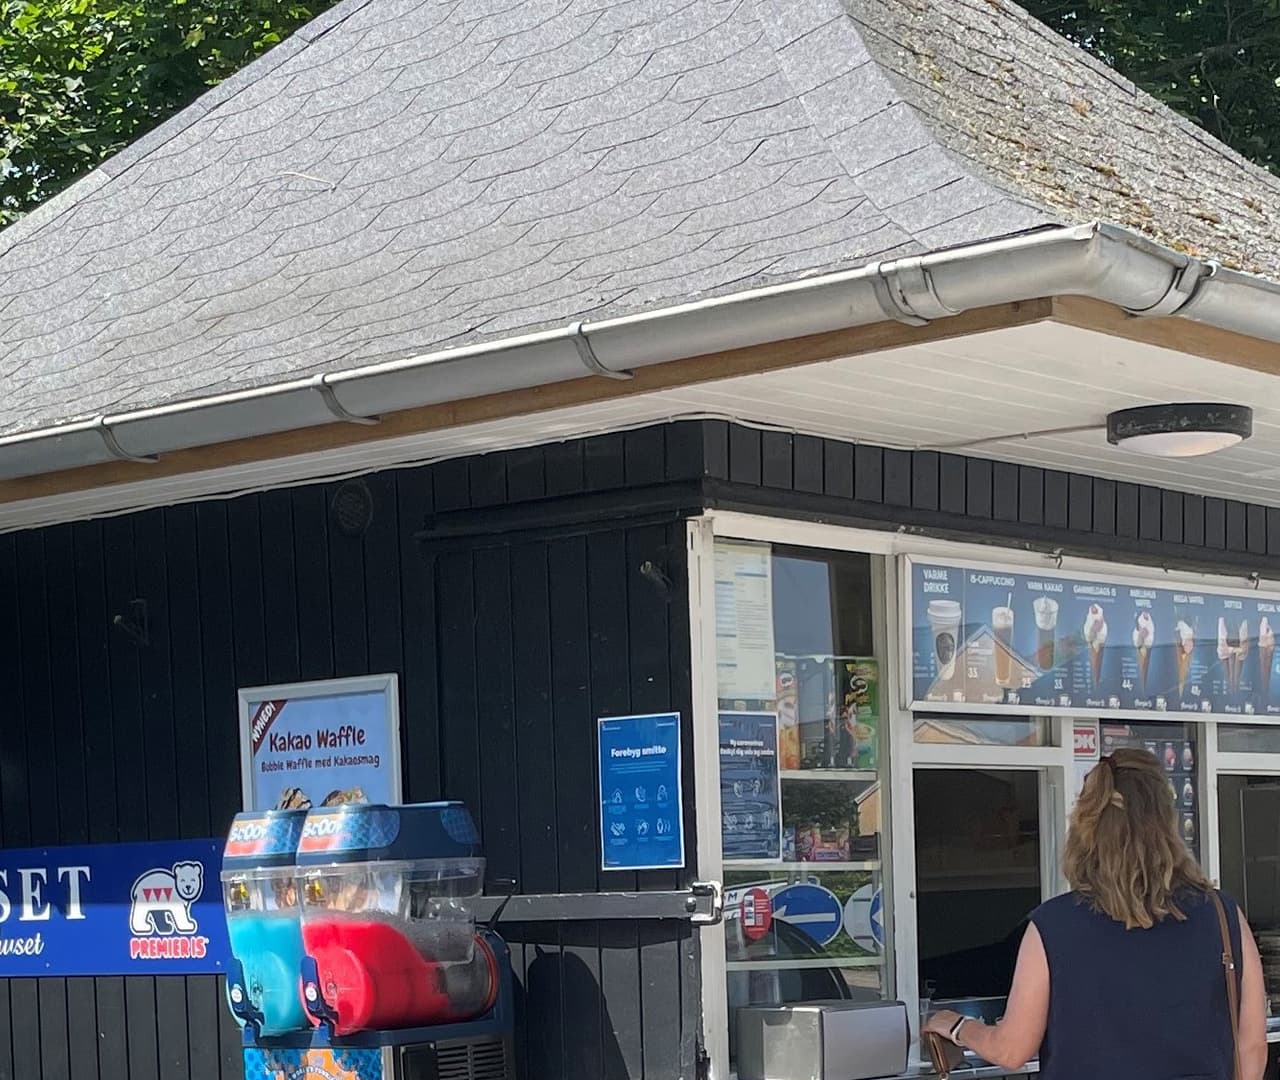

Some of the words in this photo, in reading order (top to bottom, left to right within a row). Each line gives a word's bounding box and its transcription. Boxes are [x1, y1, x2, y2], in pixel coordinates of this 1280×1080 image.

[270, 731, 312, 752] Kakao
[317, 725, 366, 748] Waffle
[611, 748, 641, 758] Forebyg
[642, 745, 667, 756] smitte
[261, 760, 284, 773] Bubble
[286, 757, 312, 770] Waffle
[315, 757, 332, 768] med
[334, 754, 380, 769] Kakaosmag
[130, 937, 190, 959] PREMIER
[190, 936, 207, 958] IS
